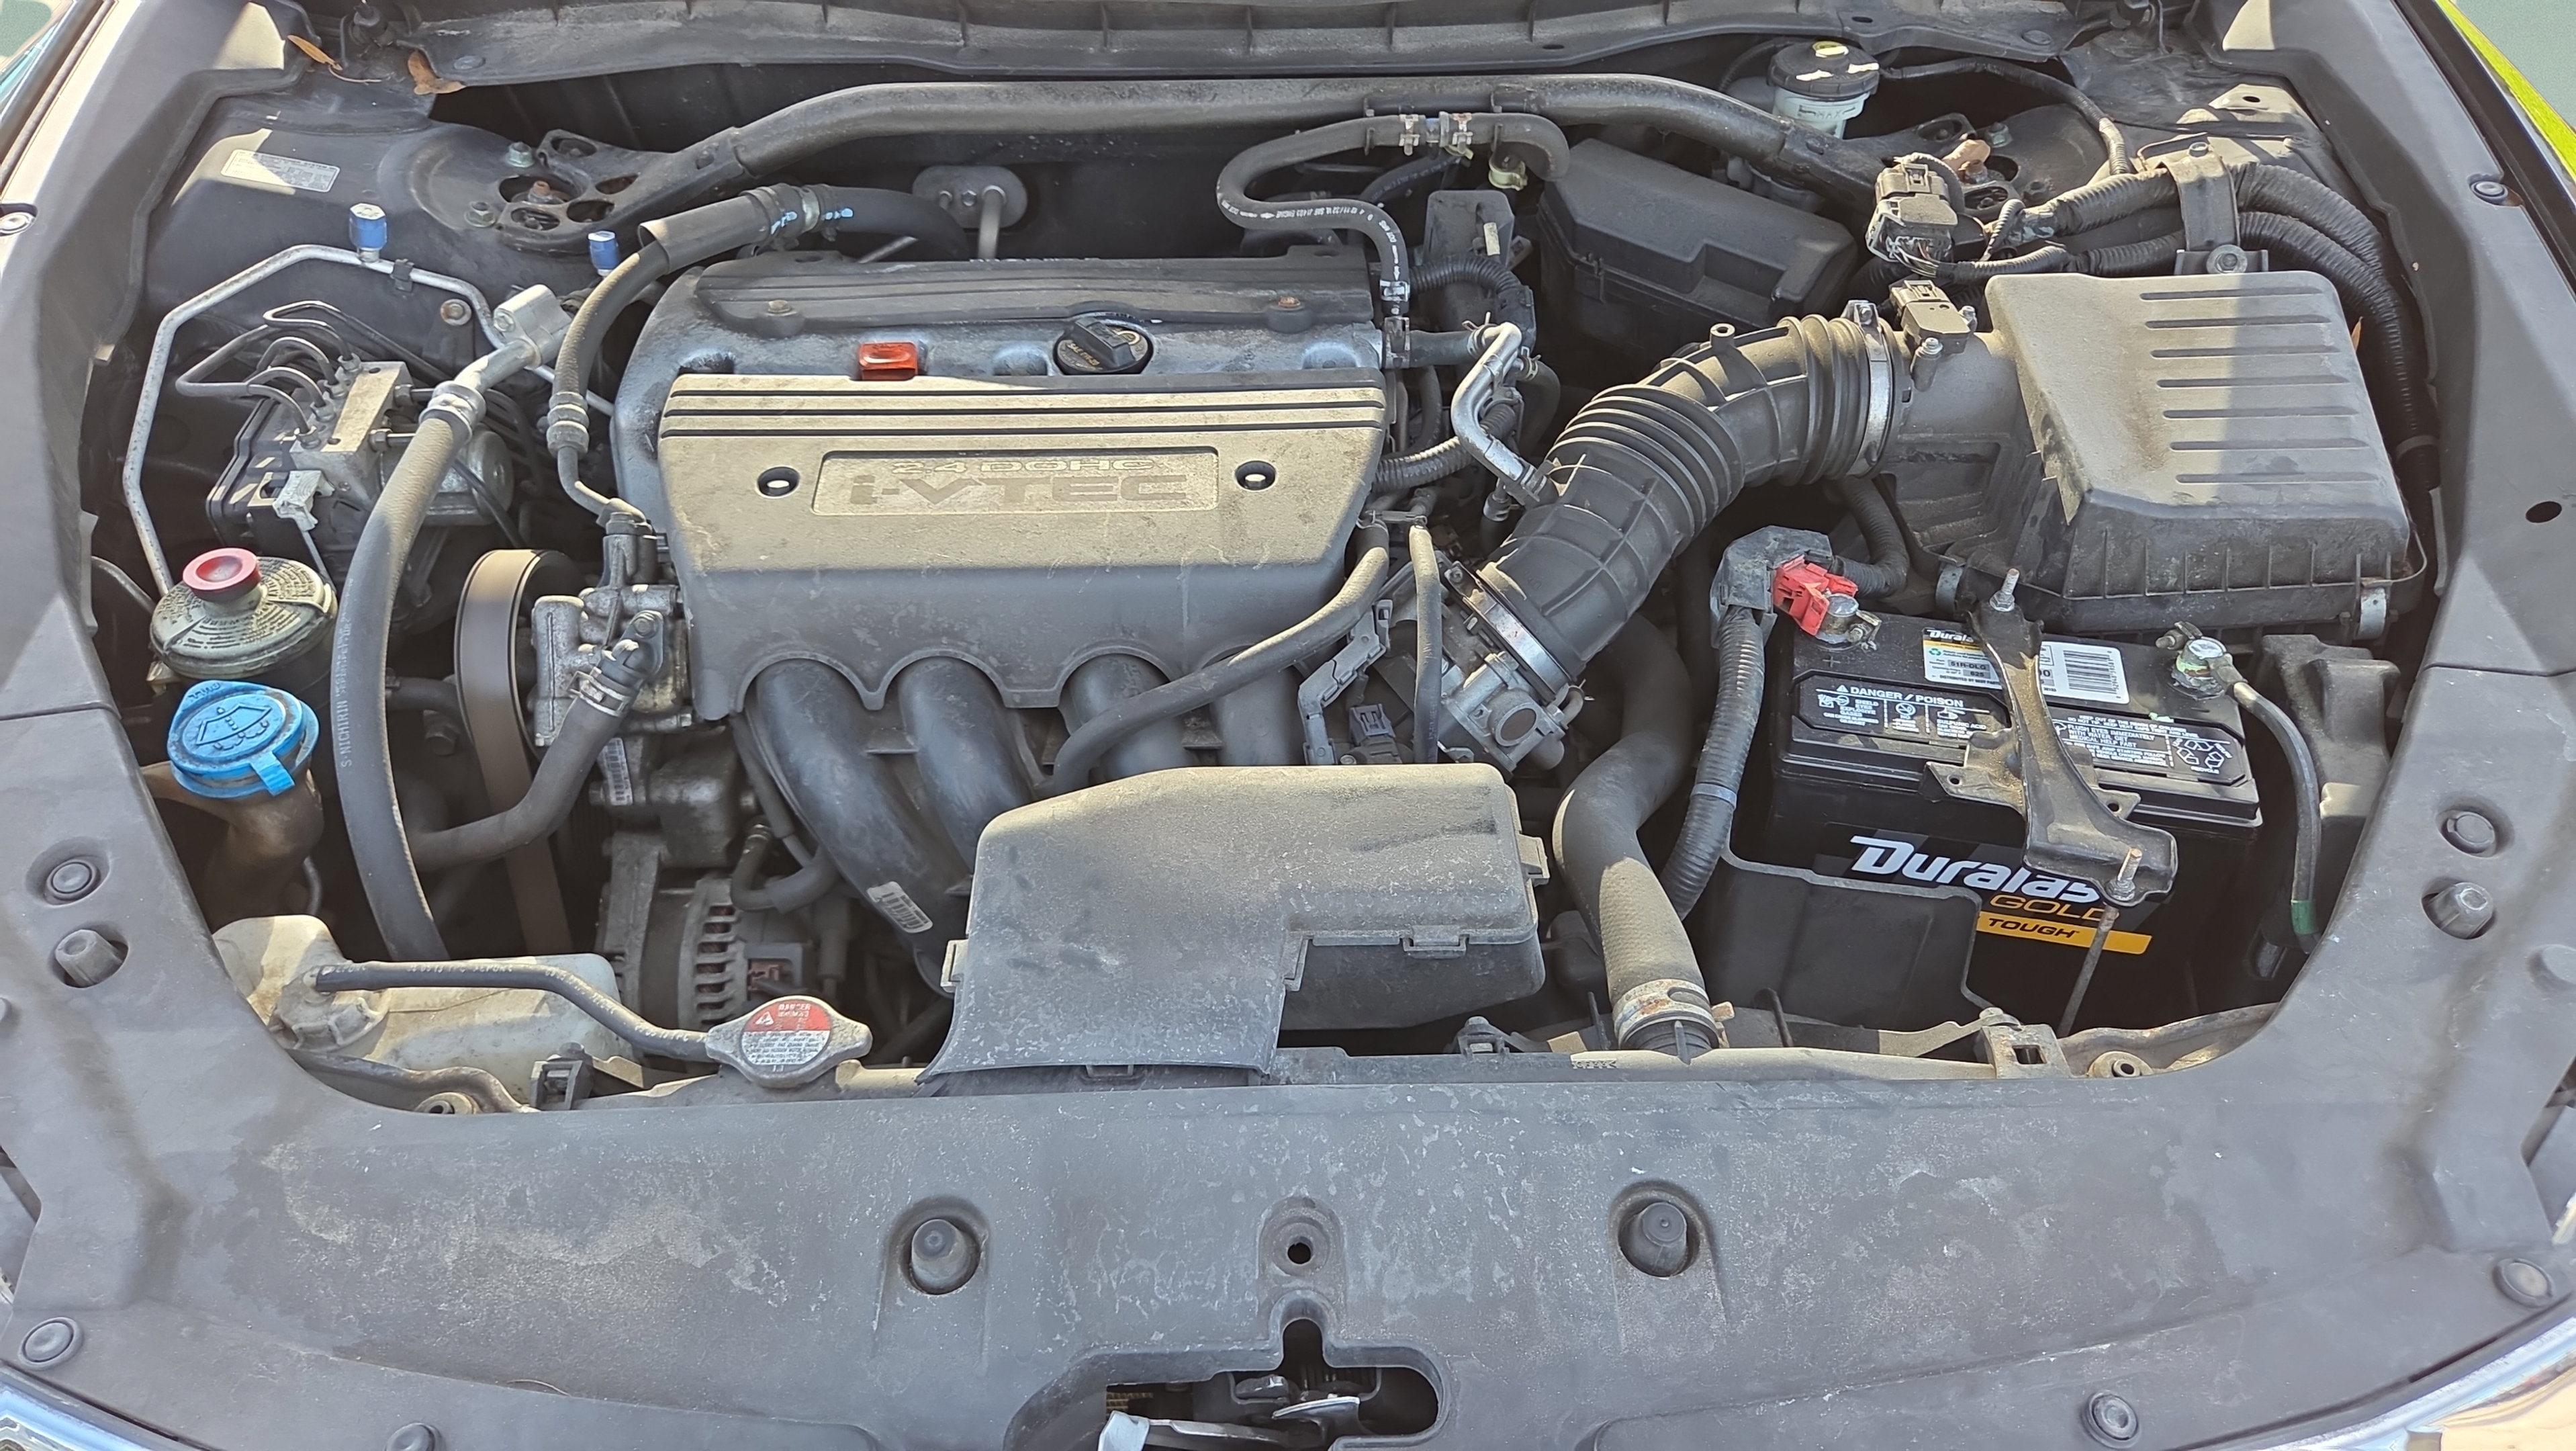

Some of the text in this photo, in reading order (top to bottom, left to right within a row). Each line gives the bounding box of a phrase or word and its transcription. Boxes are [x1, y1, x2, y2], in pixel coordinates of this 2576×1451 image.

[892, 459, 1155, 474] 2.4 DOHC
[849, 474, 1187, 505] i-VTEC
[1850, 686, 1903, 699] DANGER
[1915, 695, 1964, 707] POISON
[2068, 724, 2090, 732] FLUSH
[2110, 730, 2155, 741] IMMEDIATELY
[2069, 734, 2099, 742] MEDICAL
[1989, 894, 2120, 922] GOLD
